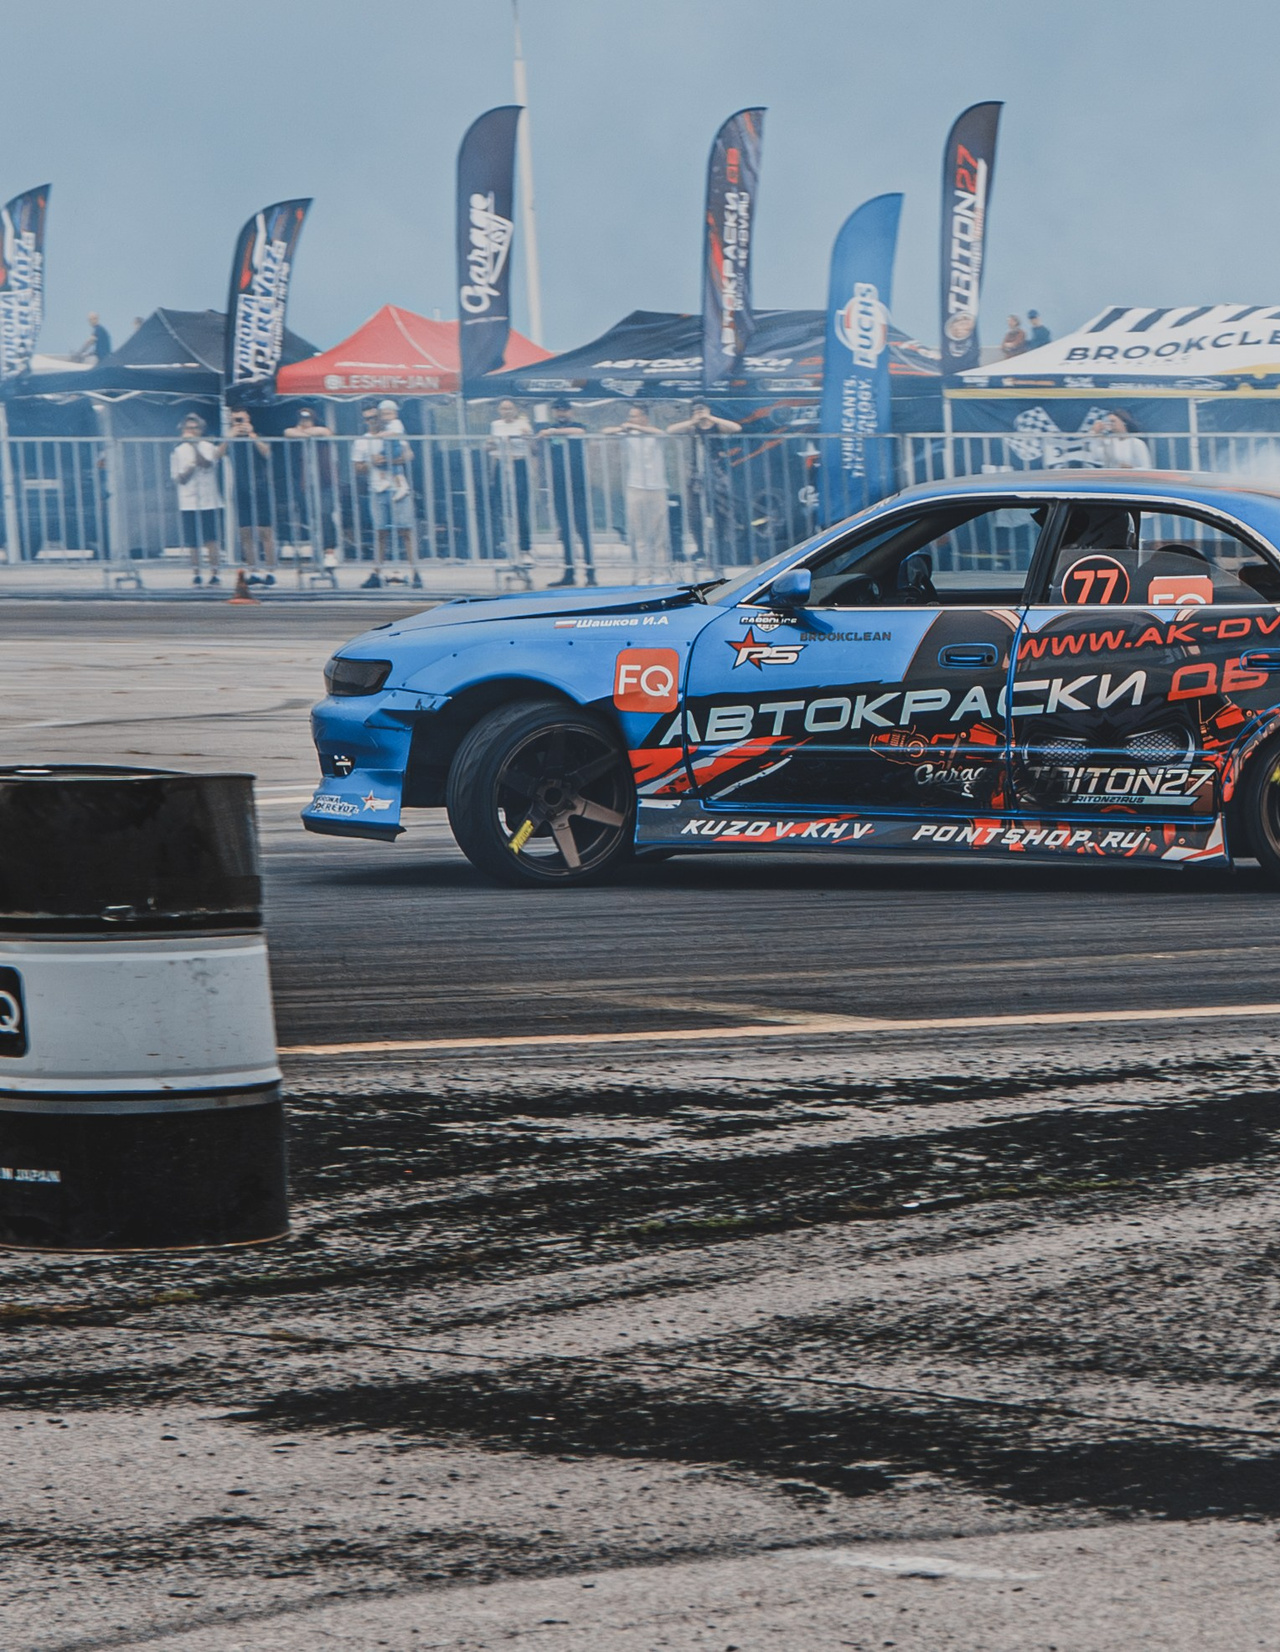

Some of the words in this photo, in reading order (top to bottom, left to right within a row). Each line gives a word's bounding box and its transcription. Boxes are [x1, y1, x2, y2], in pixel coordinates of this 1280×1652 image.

[948, 144, 979, 315] TRITON27
[460, 192, 501, 314] Garage
[855, 284, 876, 366] FUCHS
[1072, 568, 1120, 604] 77
[576, 618, 639, 628] Шашков
[642, 615, 670, 626] И.А
[800, 631, 891, 642] BROOKCLEAN
[618, 664, 674, 697] FQ
[659, 671, 1147, 746] АВТОКРАСКИ
[912, 824, 1147, 848] PONTSHOP.RU
